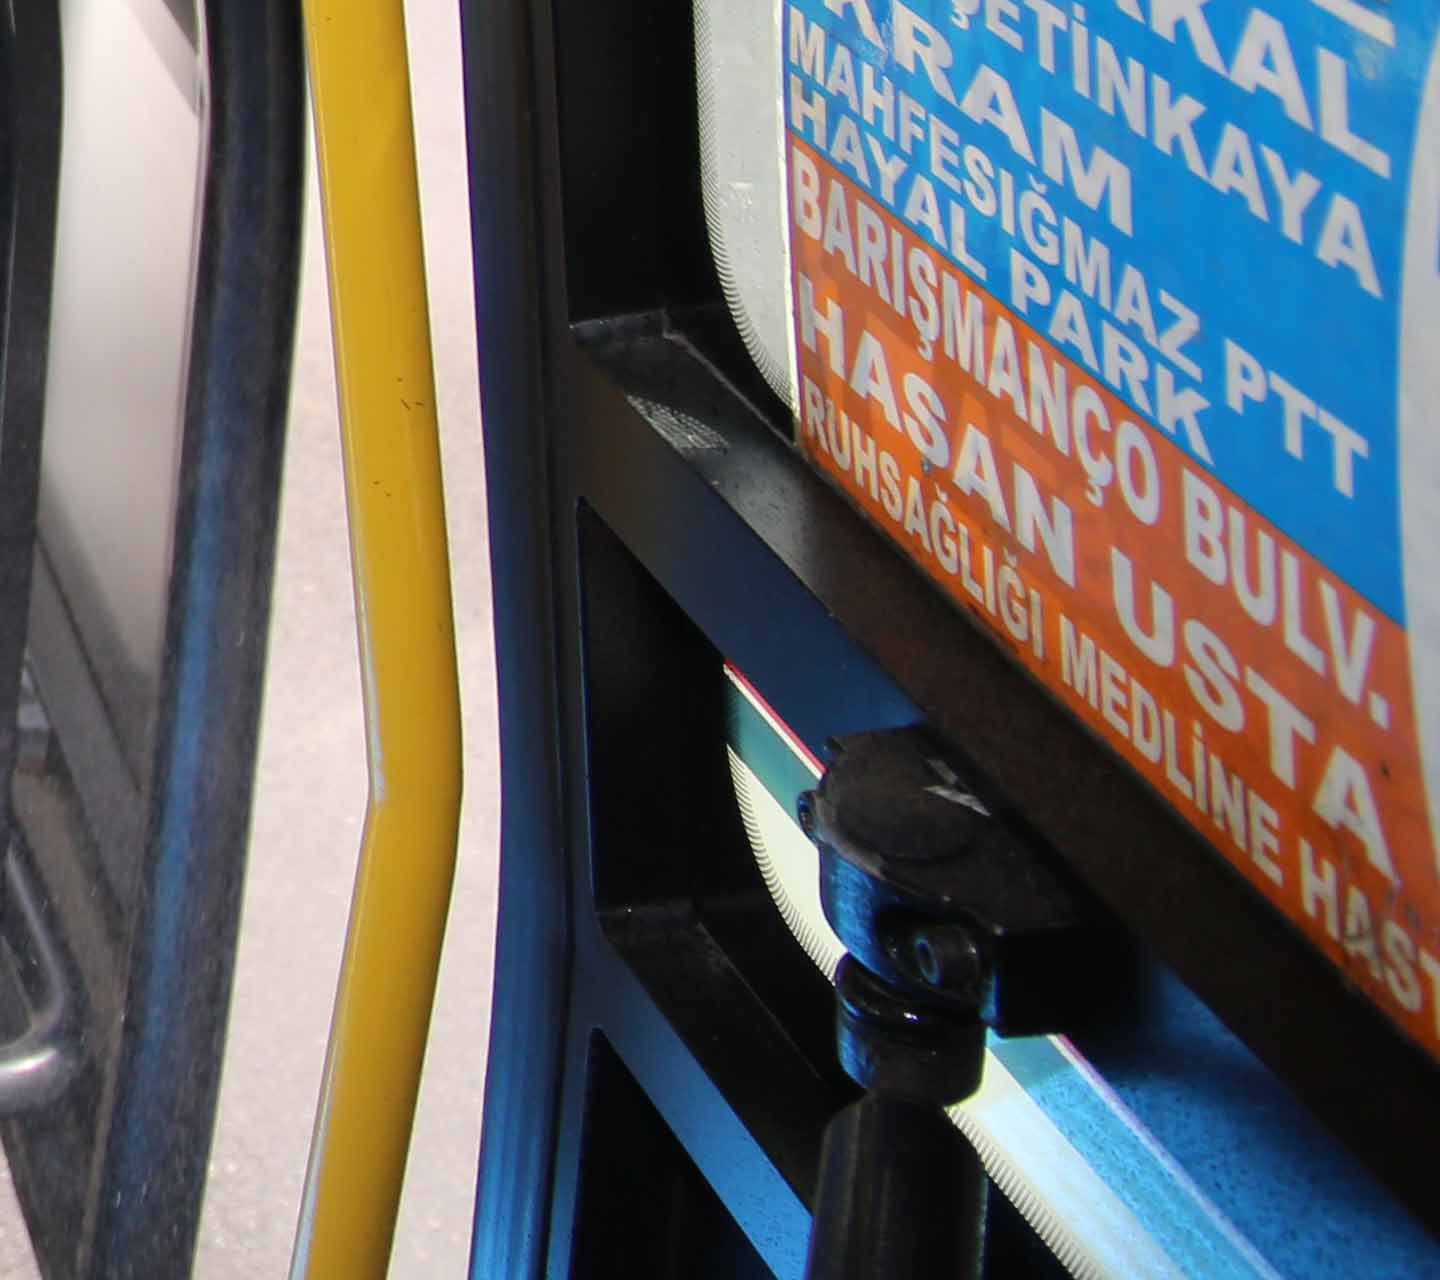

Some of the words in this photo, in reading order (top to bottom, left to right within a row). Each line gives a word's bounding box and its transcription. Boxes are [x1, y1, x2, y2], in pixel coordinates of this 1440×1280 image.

[788, 4, 1203, 383] MAHFESIĞMAZ
[1224, 337, 1370, 500] PTT
[790, 71, 988, 281] HAYAL
[1009, 246, 1216, 467] PARK
[790, 143, 1160, 526] BARIŞMANÇO
[1183, 467, 1390, 730] BULV.
[798, 271, 1076, 590] HASAN
[1110, 545, 1397, 881] USTA
[802, 374, 1045, 660] RUHSAĞLIĞI
[1058, 612, 1284, 888] MEDLİNE
